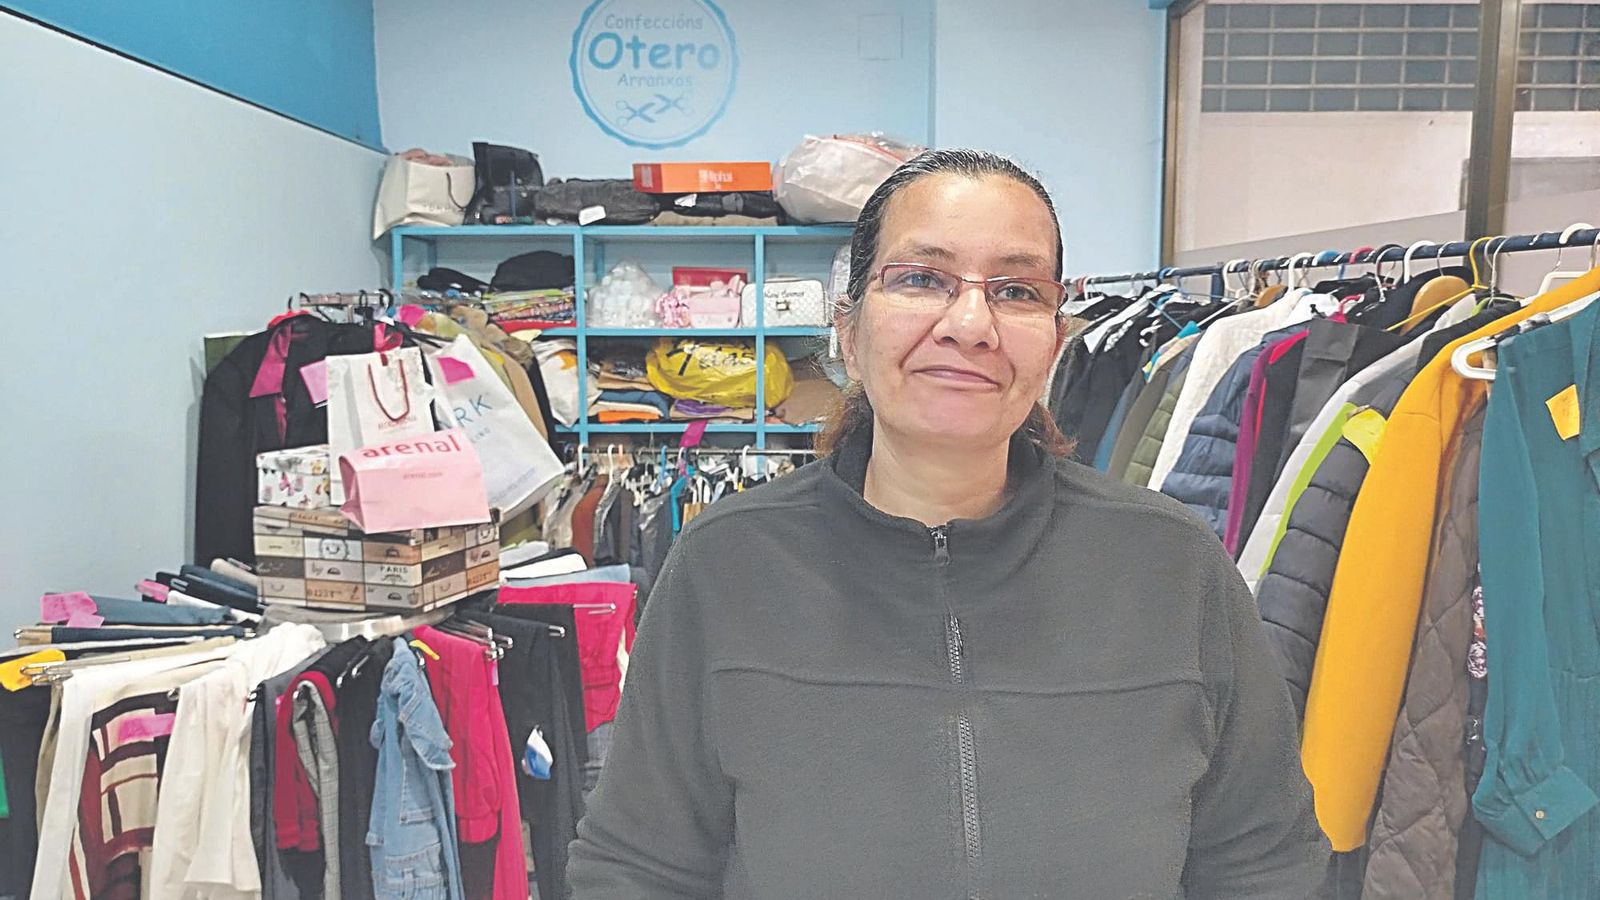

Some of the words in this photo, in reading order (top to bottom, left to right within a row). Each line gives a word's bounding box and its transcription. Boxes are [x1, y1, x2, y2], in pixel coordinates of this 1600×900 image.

[604, 14, 703, 29] Confeccións
[588, 32, 721, 70] Otero
[617, 73, 693, 87] Arranxos
[361, 434, 462, 458] arenal
[380, 566, 408, 574] PARIS
